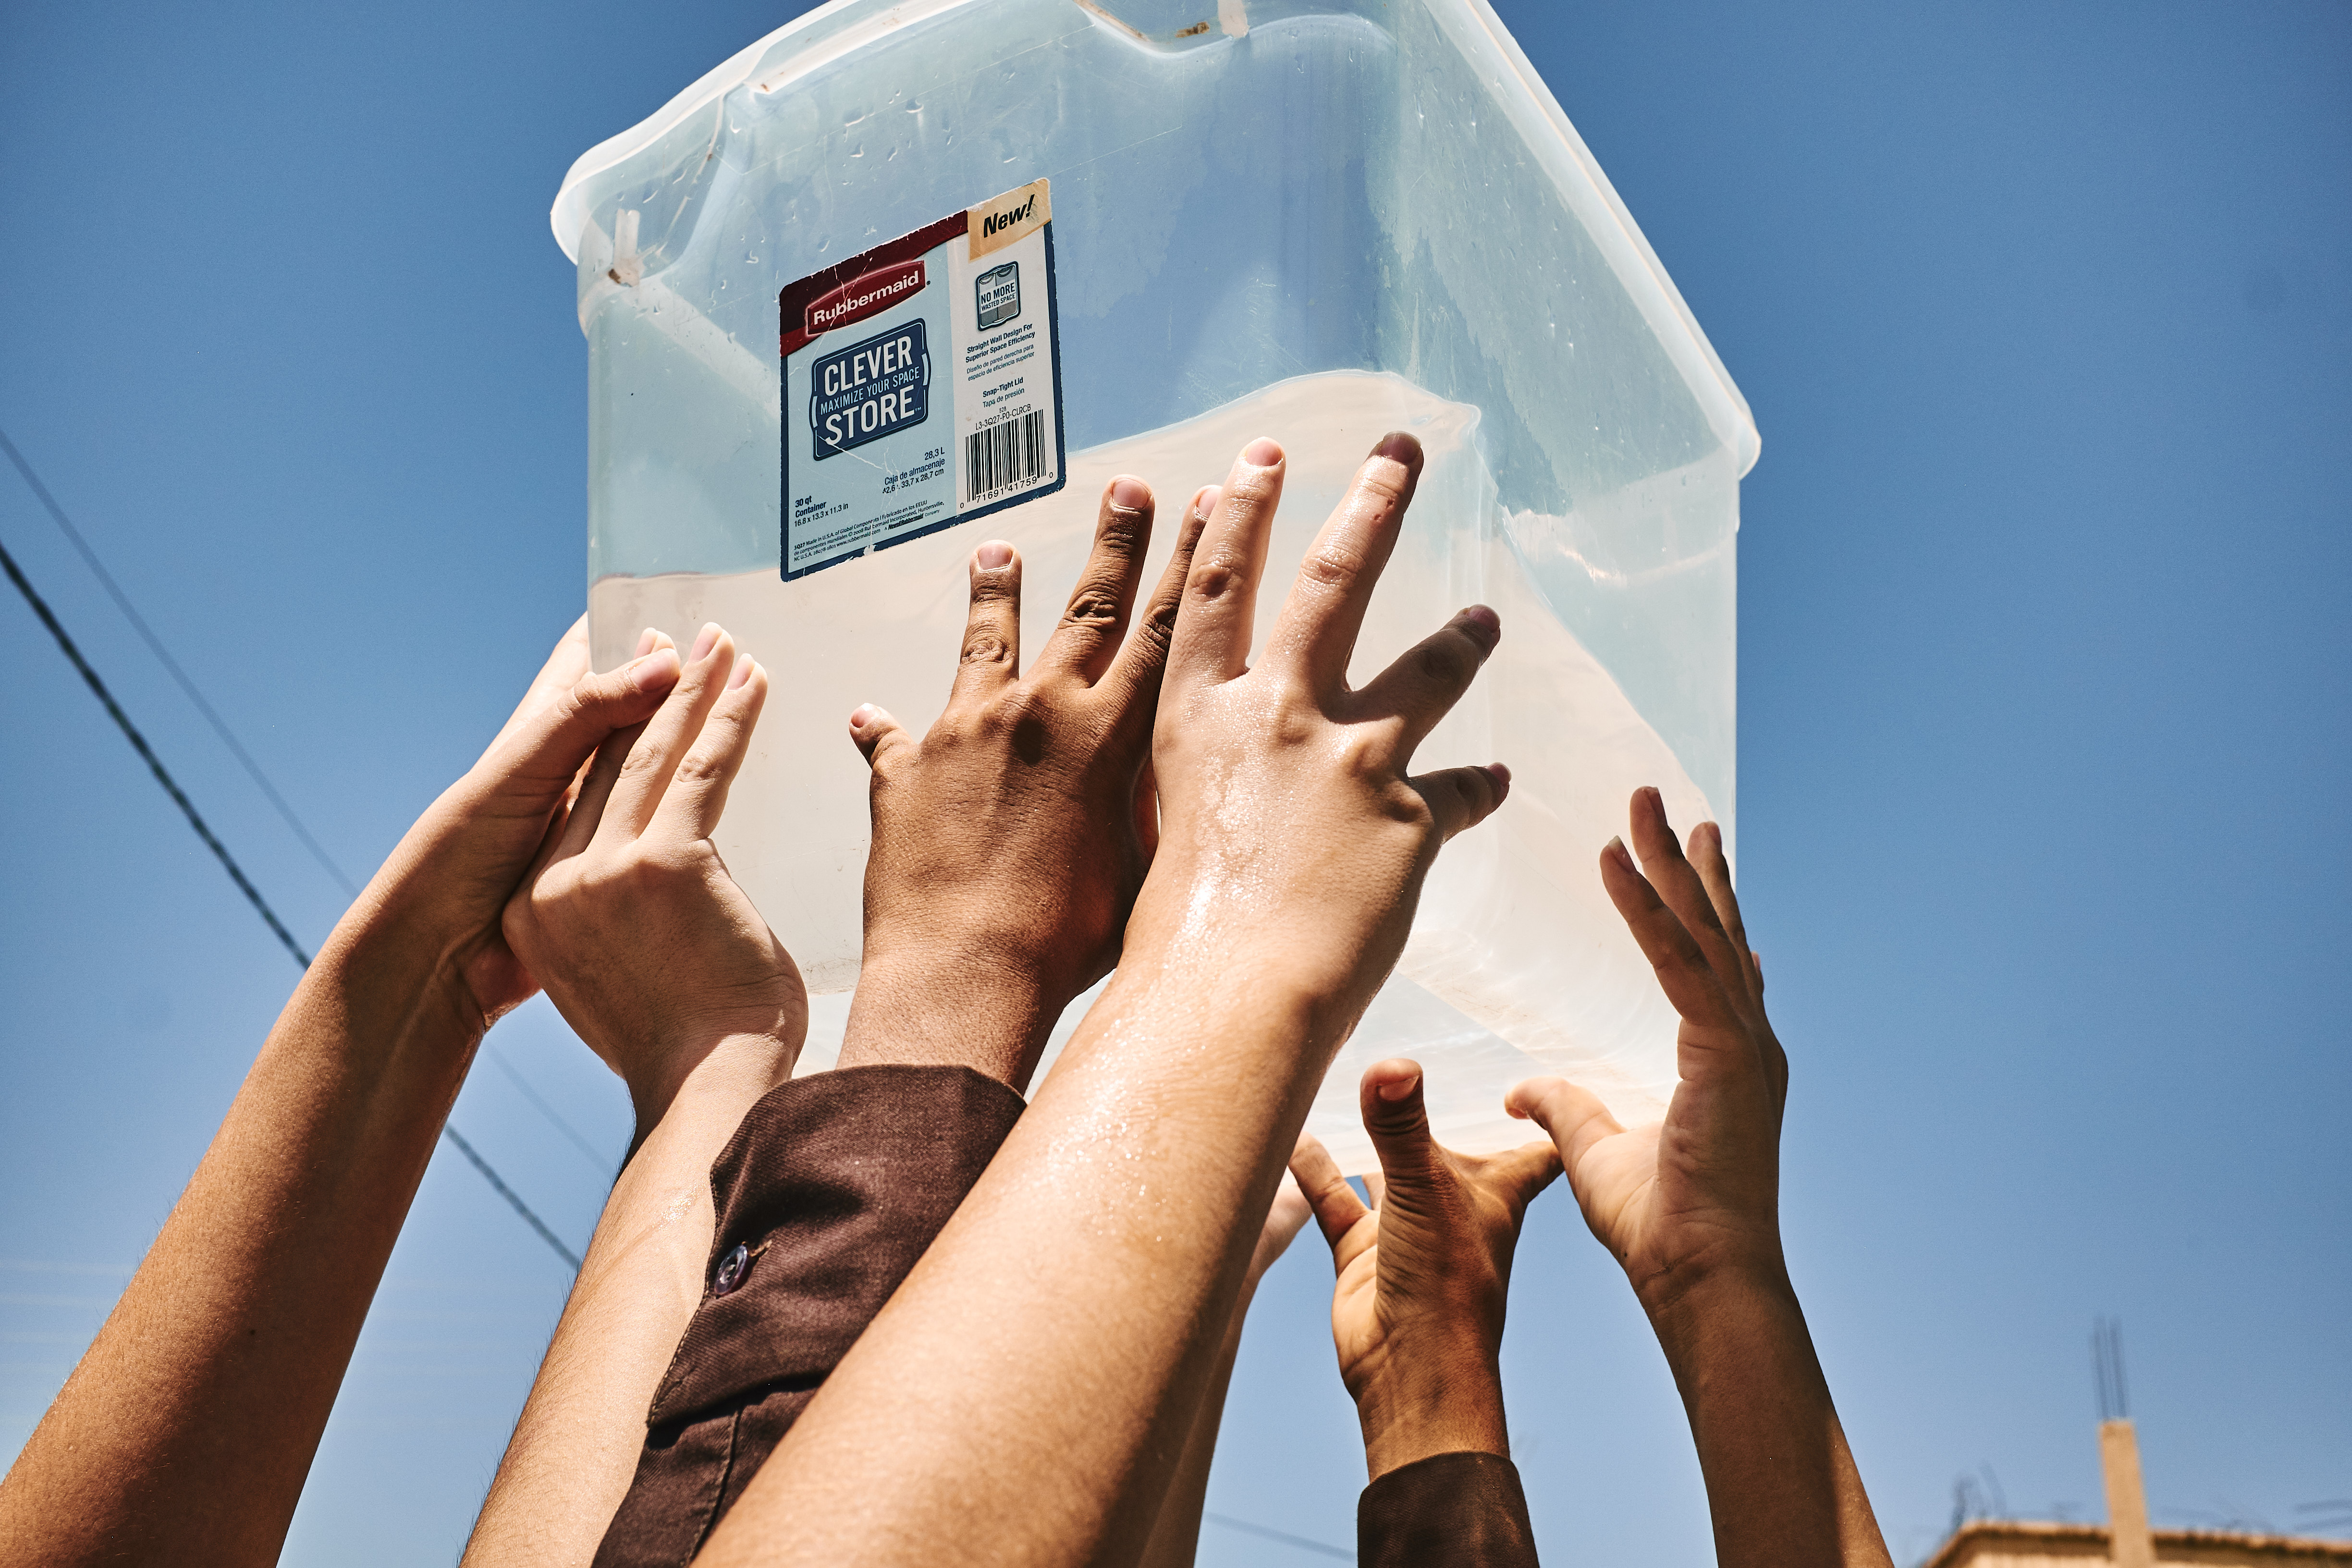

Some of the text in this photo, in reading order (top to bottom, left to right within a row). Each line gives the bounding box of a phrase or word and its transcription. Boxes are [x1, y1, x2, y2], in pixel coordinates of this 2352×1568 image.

[983, 194, 1035, 238] New!
[813, 270, 919, 326] Rubbermaid
[981, 282, 1015, 305] NO MORE
[981, 293, 1016, 311] WASTED SPACE
[966, 331, 1035, 363] Superior Space Efficiency
[967, 323, 1032, 354] Straight Wall Design For
[824, 335, 913, 397] CLEVER
[967, 363, 982, 374] Diseño
[990, 355, 1003, 366] pared
[1004, 348, 1022, 359] derecha
[1023, 344, 1034, 353] para
[968, 370, 985, 381] espacio
[993, 360, 1015, 371] eficiencia
[1016, 351, 1034, 363] superior
[820, 366, 920, 415] MAXIMIZE YOUR SPACE
[982, 399, 995, 408] Tapa
[1004, 388, 1025, 401] presión
[983, 377, 1023, 397] Snap-Tight Lid
[825, 384, 915, 446] STORE
[924, 448, 939, 460] 28,3
[884, 458, 945, 485] Caja de almacenaje
[901, 478, 914, 488] 33,7
[920, 471, 933, 482] 28,7
[934, 468, 944, 477] cm
[795, 495, 812, 508] 30 qt
[976, 487, 1004, 503] 71691
[1008, 476, 1037, 491] 41759
[794, 517, 806, 527] 16.8
[812, 511, 824, 521] 13.3
[830, 504, 842, 514] 11.3
[795, 502, 826, 518] Container
[840, 526, 854, 534] Global
[916, 500, 928, 508] EEUU
[800, 541, 826, 554] componentes
